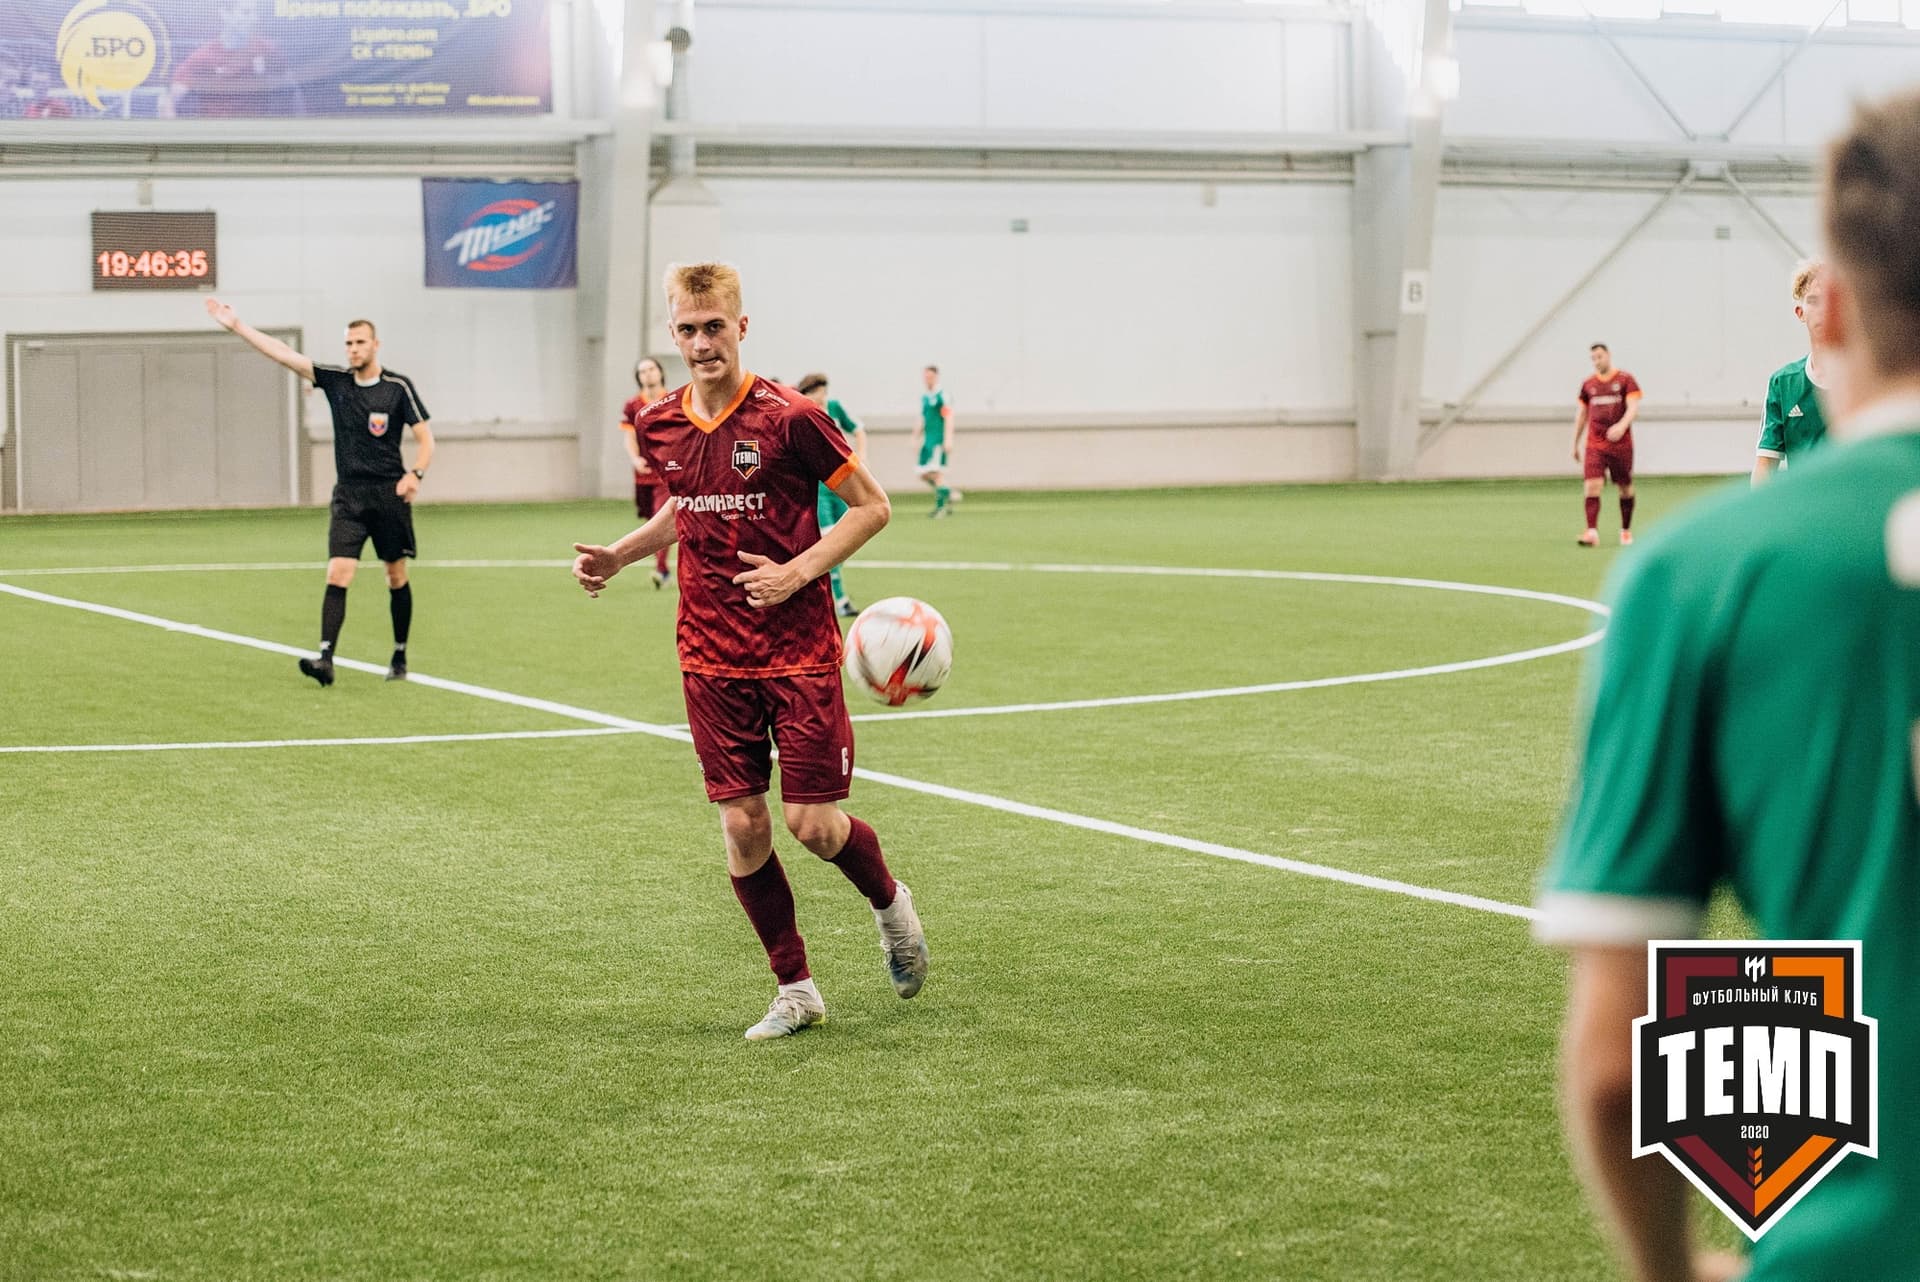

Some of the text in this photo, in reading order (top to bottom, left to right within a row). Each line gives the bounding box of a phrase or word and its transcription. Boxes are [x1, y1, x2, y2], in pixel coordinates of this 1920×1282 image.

[85, 37, 146, 58] .БРО
[97, 249, 209, 277] 19:46:35
[735, 451, 758, 465] ТЕМП
[842, 747, 849, 776] 6
